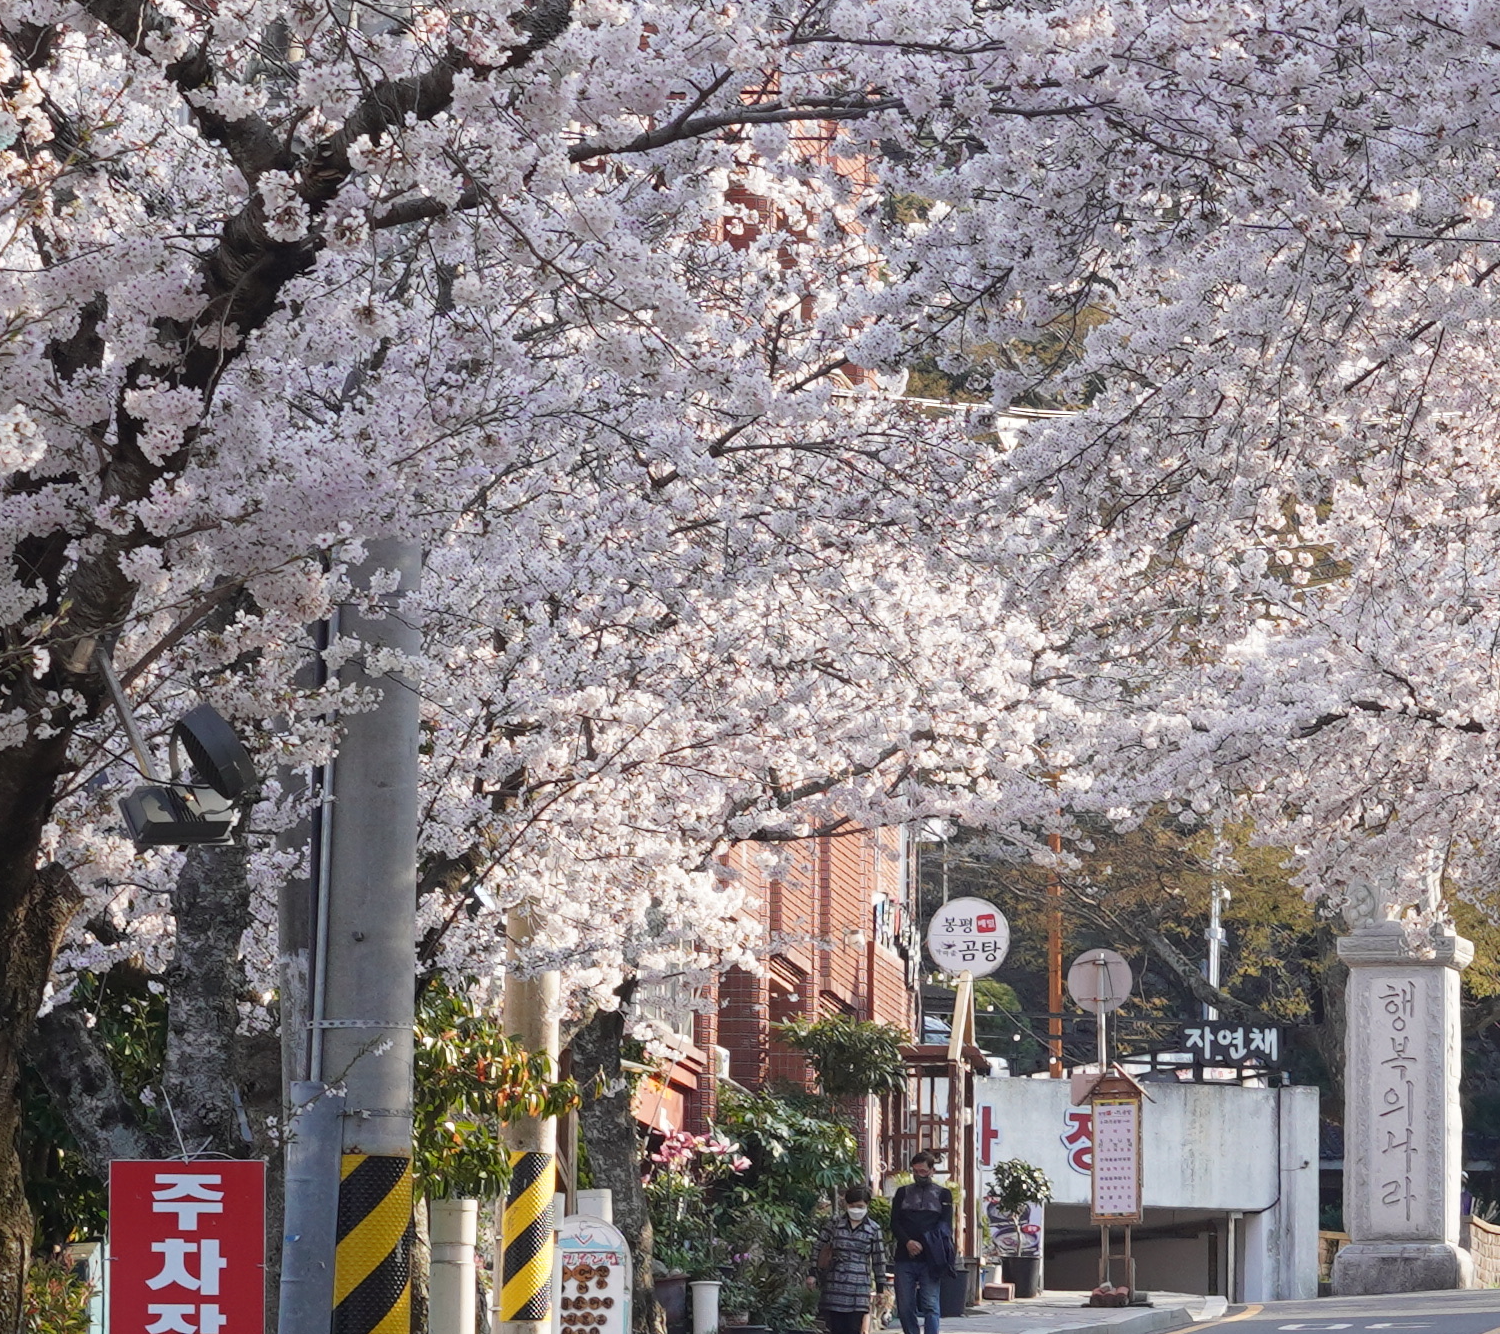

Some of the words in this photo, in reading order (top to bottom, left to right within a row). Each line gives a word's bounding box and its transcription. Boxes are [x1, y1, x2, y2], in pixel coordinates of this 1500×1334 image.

[941, 916, 973, 934] 봉평
[958, 940, 1003, 962] 곰탕
[1183, 1026, 1278, 1062] 자연채
